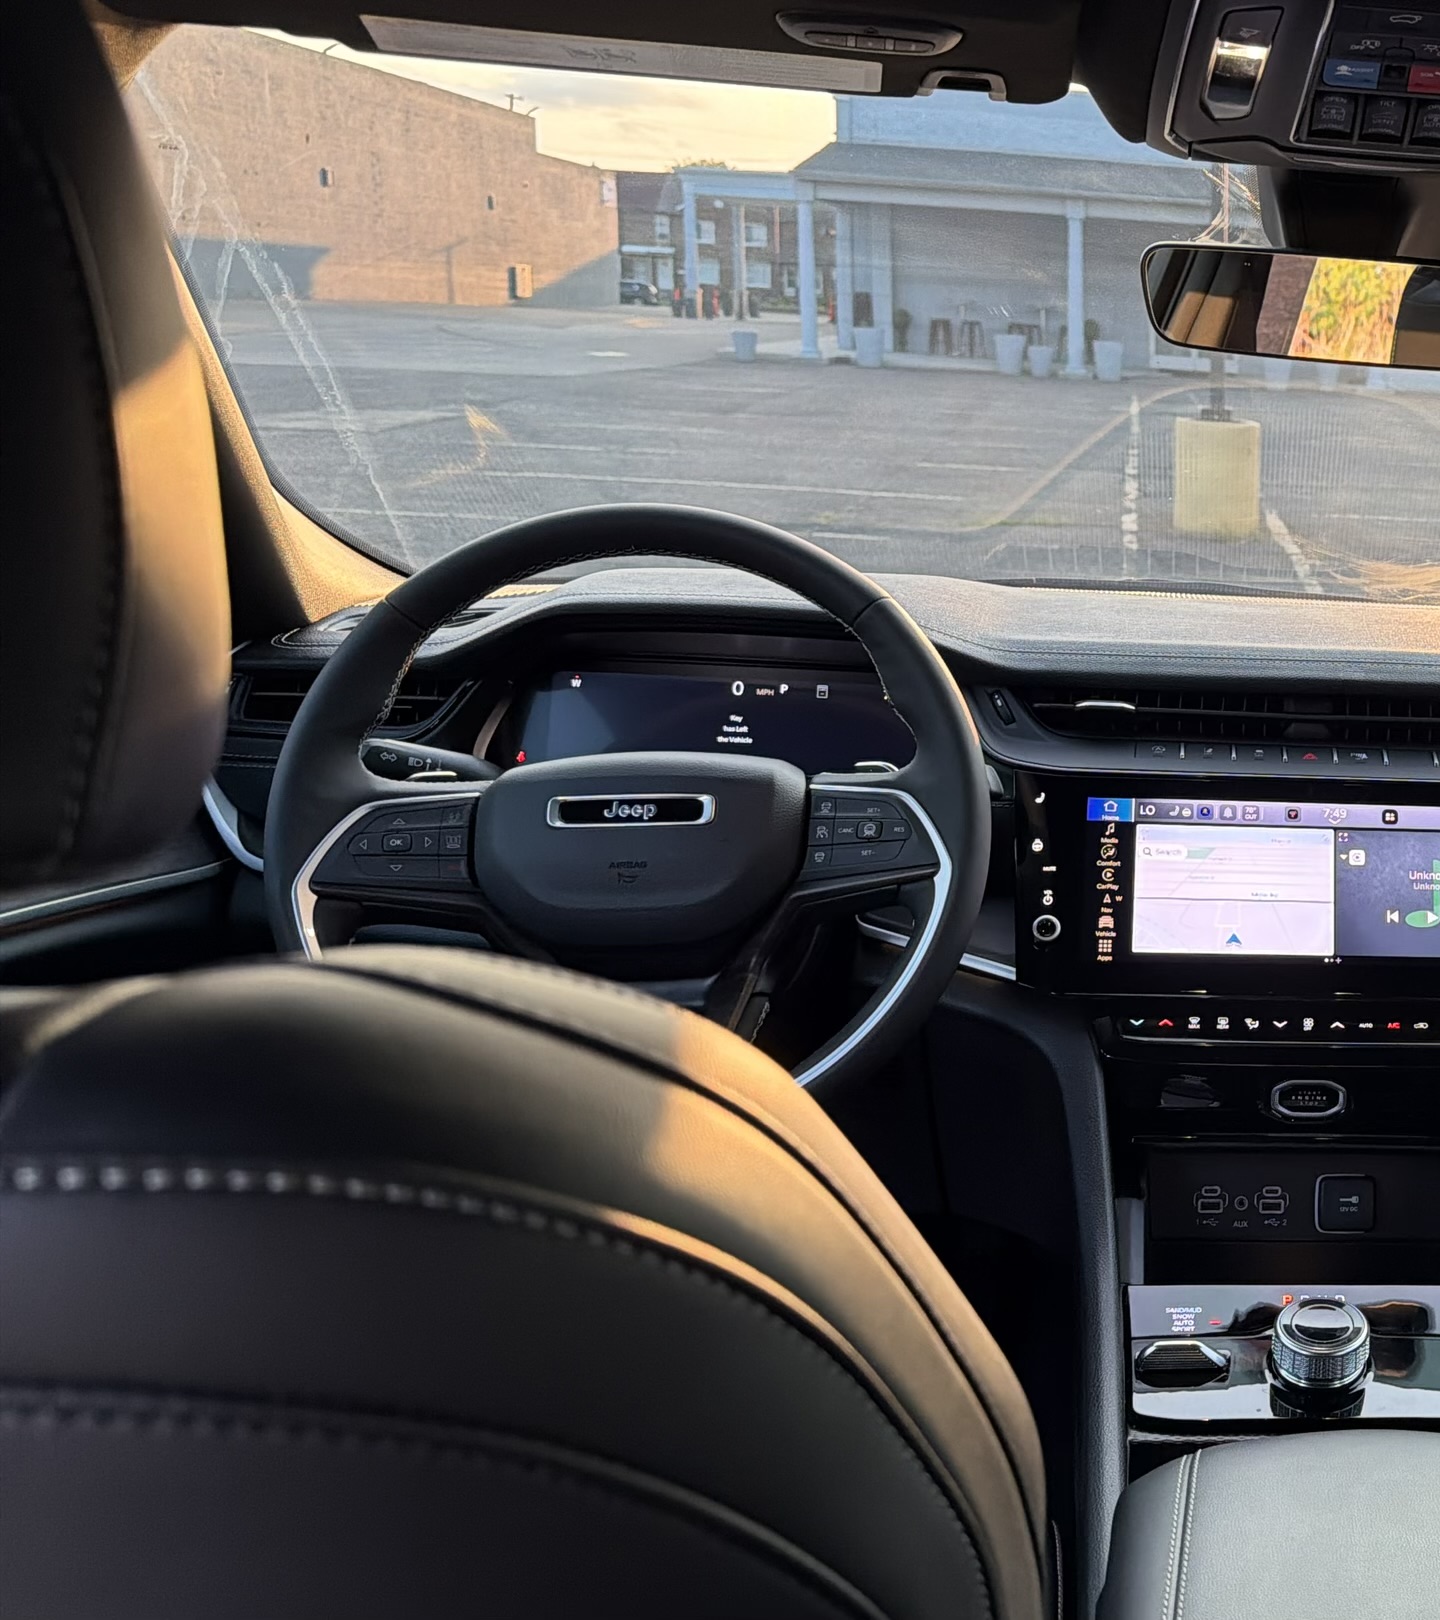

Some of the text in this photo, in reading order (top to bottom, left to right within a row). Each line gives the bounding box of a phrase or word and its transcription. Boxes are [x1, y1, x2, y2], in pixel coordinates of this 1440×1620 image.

[571, 679, 581, 687] W
[756, 688, 775, 696] MPH
[780, 684, 789, 694] P
[729, 714, 743, 723] Key
[722, 725, 749, 733] has Left
[729, 736, 753, 744] Vehicle
[603, 801, 658, 820] Jeep
[1139, 805, 1156, 816] LO
[1323, 808, 1347, 819] 7:49
[389, 838, 403, 846] OK
[608, 860, 648, 869] AIRBAG
[1096, 883, 1119, 891] CarPlay
[1232, 1220, 1248, 1228] AUX
[1282, 1295, 1293, 1306] P
